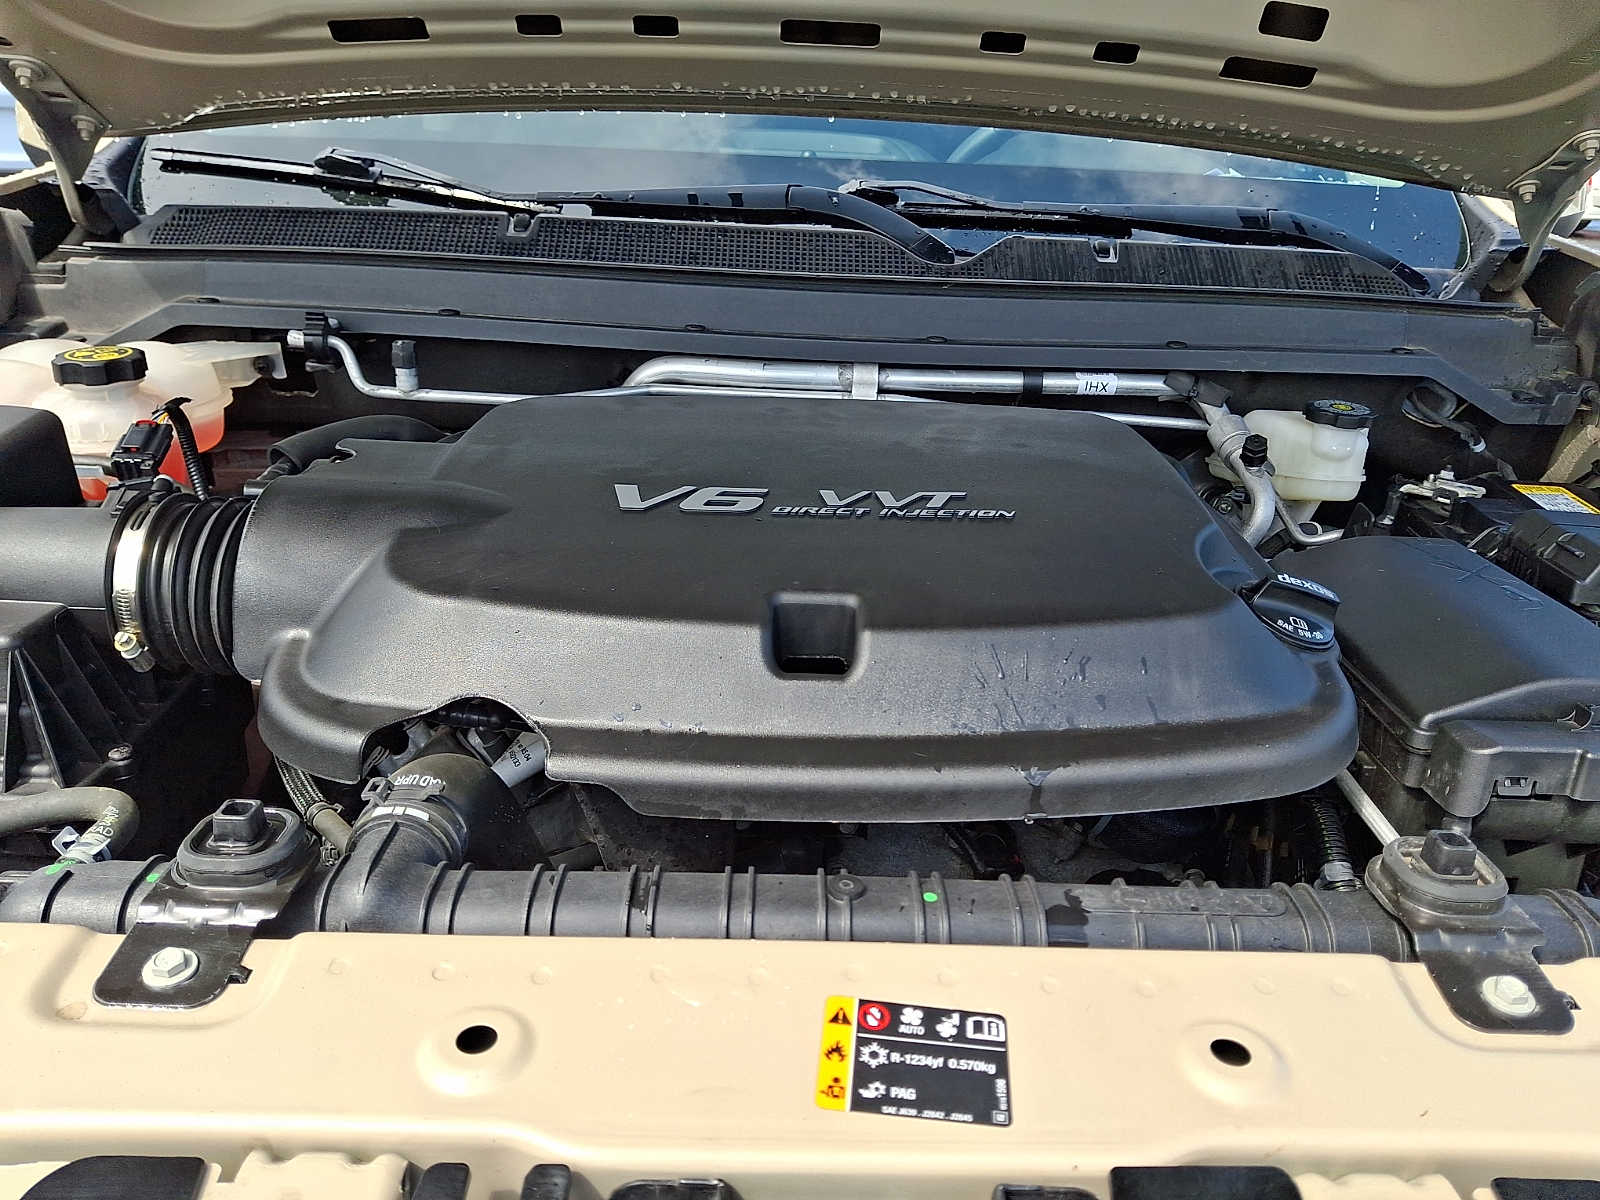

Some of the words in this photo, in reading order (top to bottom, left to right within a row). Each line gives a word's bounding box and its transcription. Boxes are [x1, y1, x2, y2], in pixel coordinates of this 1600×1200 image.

[614, 484, 769, 513] V6
[819, 490, 968, 508] VVT
[770, 506, 871, 517] DIRECT
[879, 507, 1017, 520] INJECTION
[1277, 619, 1294, 632] SAE
[898, 1025, 925, 1036] AUTO
[889, 1052, 945, 1069] R-1234yf
[947, 1058, 997, 1075] 0.570kg
[889, 1086, 917, 1101] PAG
